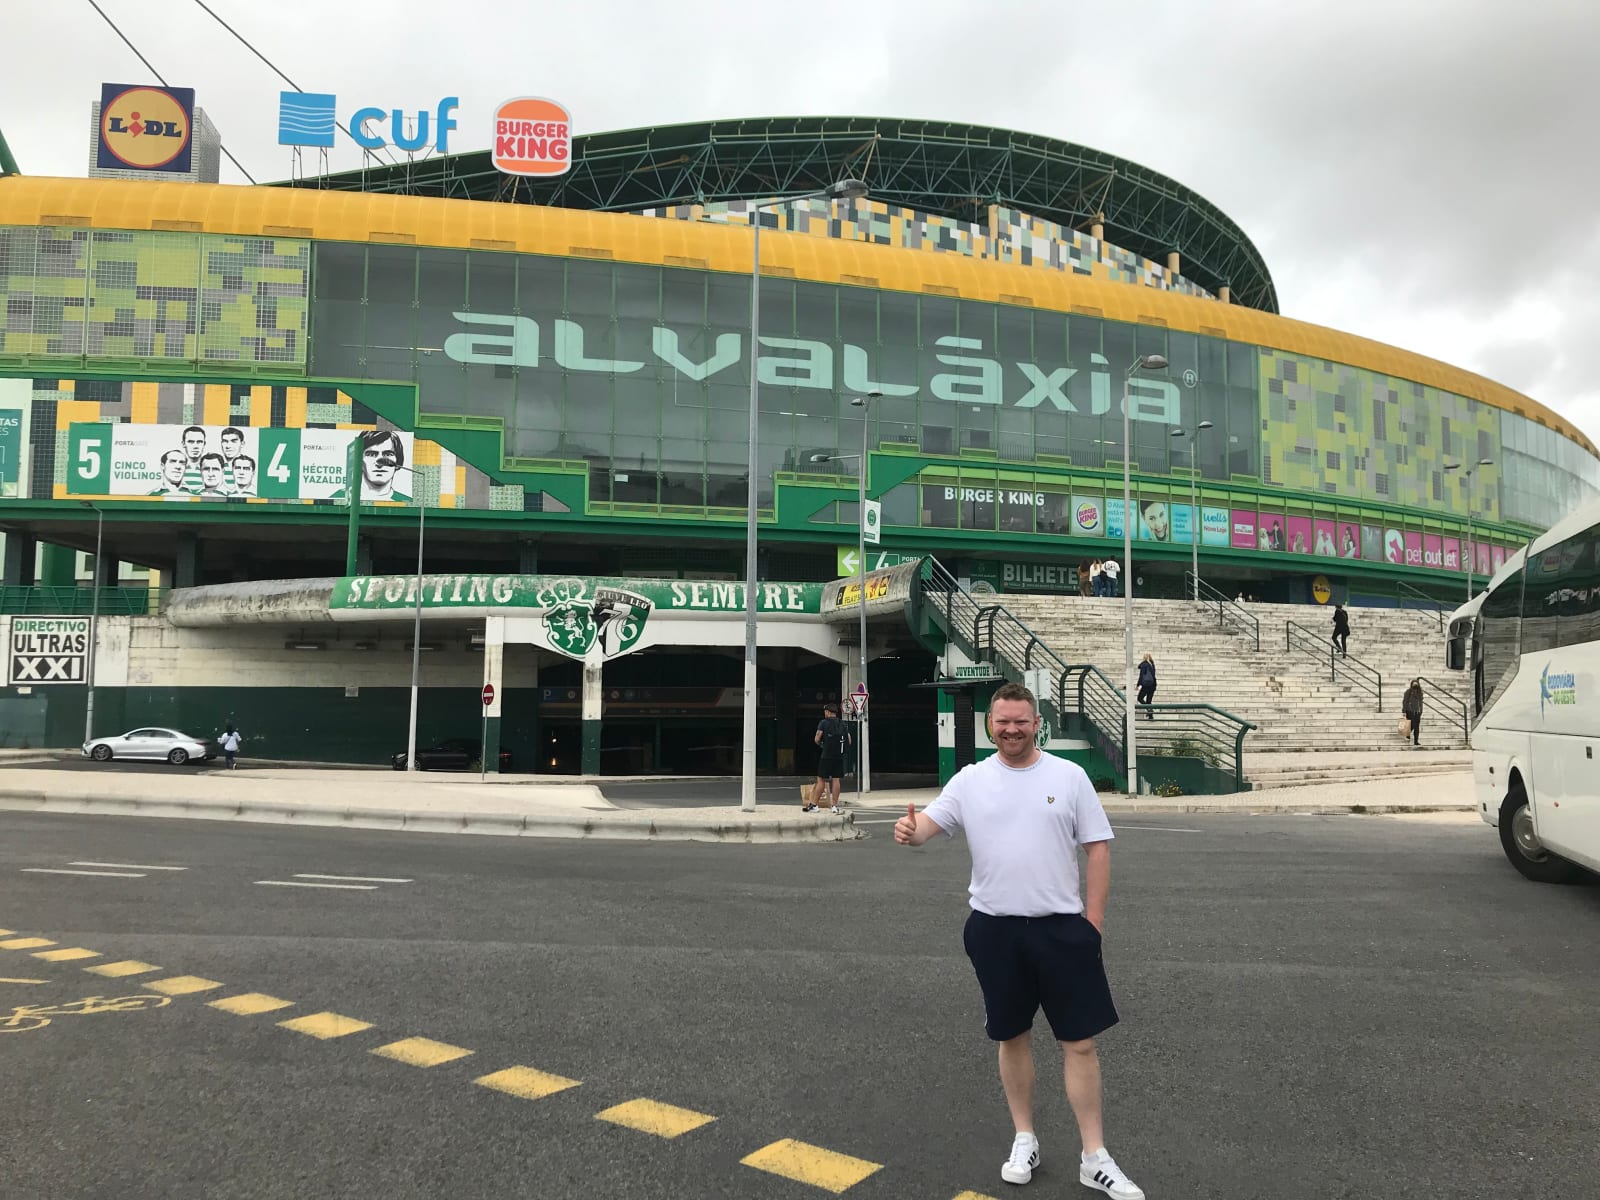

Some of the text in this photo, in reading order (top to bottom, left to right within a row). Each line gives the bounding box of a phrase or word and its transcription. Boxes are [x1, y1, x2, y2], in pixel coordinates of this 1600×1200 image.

[349, 96, 459, 154] cuf
[496, 120, 568, 138] BURGER
[496, 136, 568, 160] KING
[77, 438, 102, 480] 5
[114, 461, 146, 470] CINCO
[267, 443, 291, 483] 4
[302, 463, 342, 474] HÉCTOR
[114, 471, 162, 480] VIOLINOS
[304, 475, 347, 485] YAZALDE
[944, 486, 1045, 506] BURGER KING
[1079, 512, 1097, 523] KING
[875, 551, 889, 571] 4
[1406, 547, 1423, 566] pet
[1003, 563, 1078, 585] BILHETE
[15, 620, 87, 632] DIRECTIVO
[598, 608, 639, 642] 76
[14, 633, 86, 653] ULTRAS
[16, 657, 81, 680] XXI
